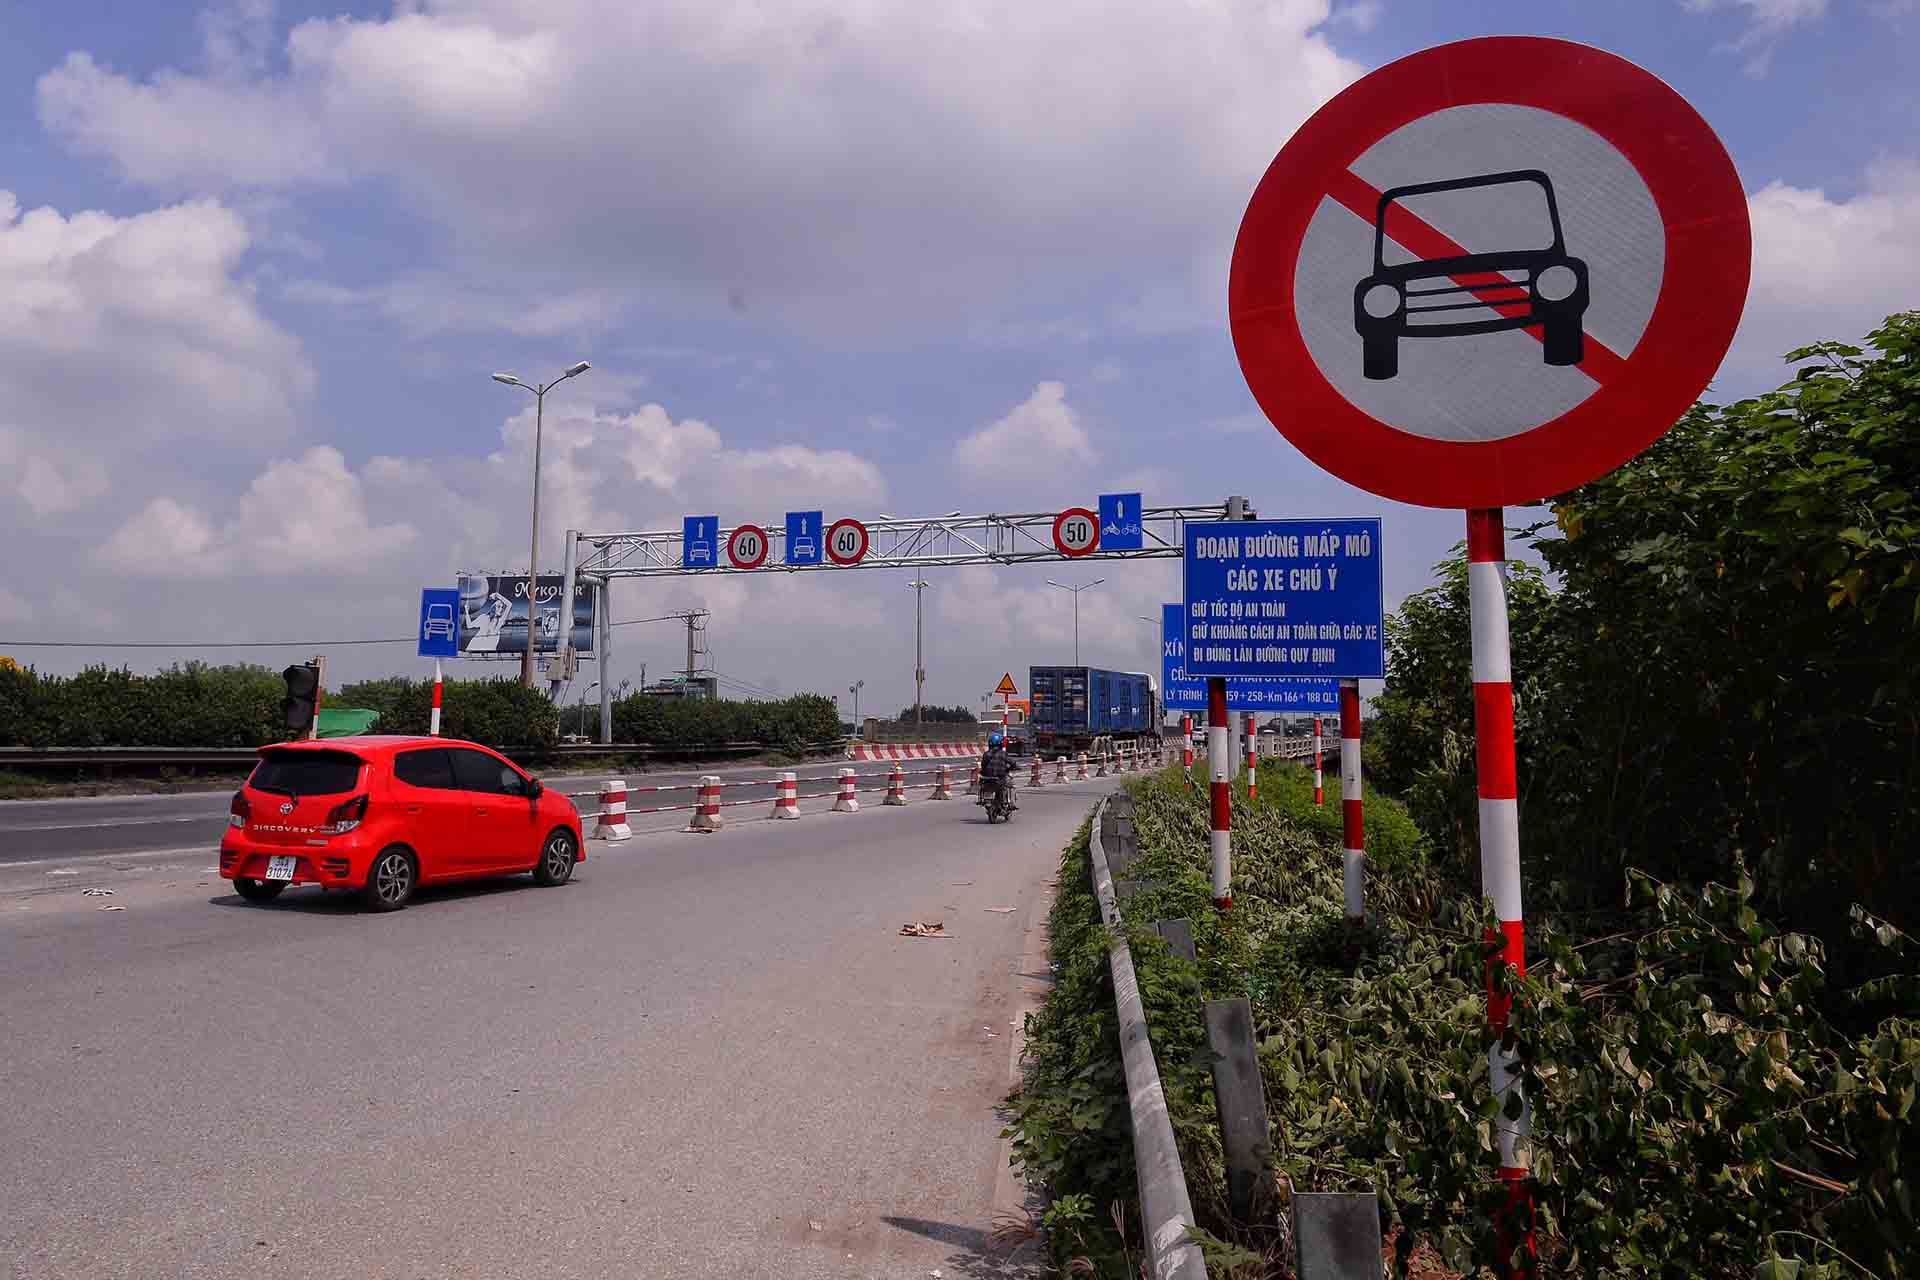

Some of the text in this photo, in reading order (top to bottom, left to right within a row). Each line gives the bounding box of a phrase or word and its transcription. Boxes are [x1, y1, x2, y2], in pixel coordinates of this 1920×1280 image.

[839, 532, 855, 552] 60
[1066, 522, 1087, 543] 50
[739, 537, 756, 556] 60
[1196, 528, 1371, 563] ĐOẠN ĐƯỜNG MẤP MÔ
[1227, 563, 1337, 591] CÁC XE CHÚ Ý
[1211, 597, 1228, 617] TỐC
[1245, 602, 1258, 617] AN
[1261, 599, 1286, 617] TOÀN
[1210, 618, 1248, 640] KHOẢNG
[1250, 621, 1275, 640] CÁCH
[1276, 624, 1290, 640] AN
[1293, 620, 1317, 640] TOÀN
[1343, 621, 1362, 640] CÁC
[1365, 624, 1377, 640] XE
[1193, 647, 1203, 663] ĐI
[1290, 647, 1309, 664] QUY
[1177, 687, 1203, 701] TRÌNH
